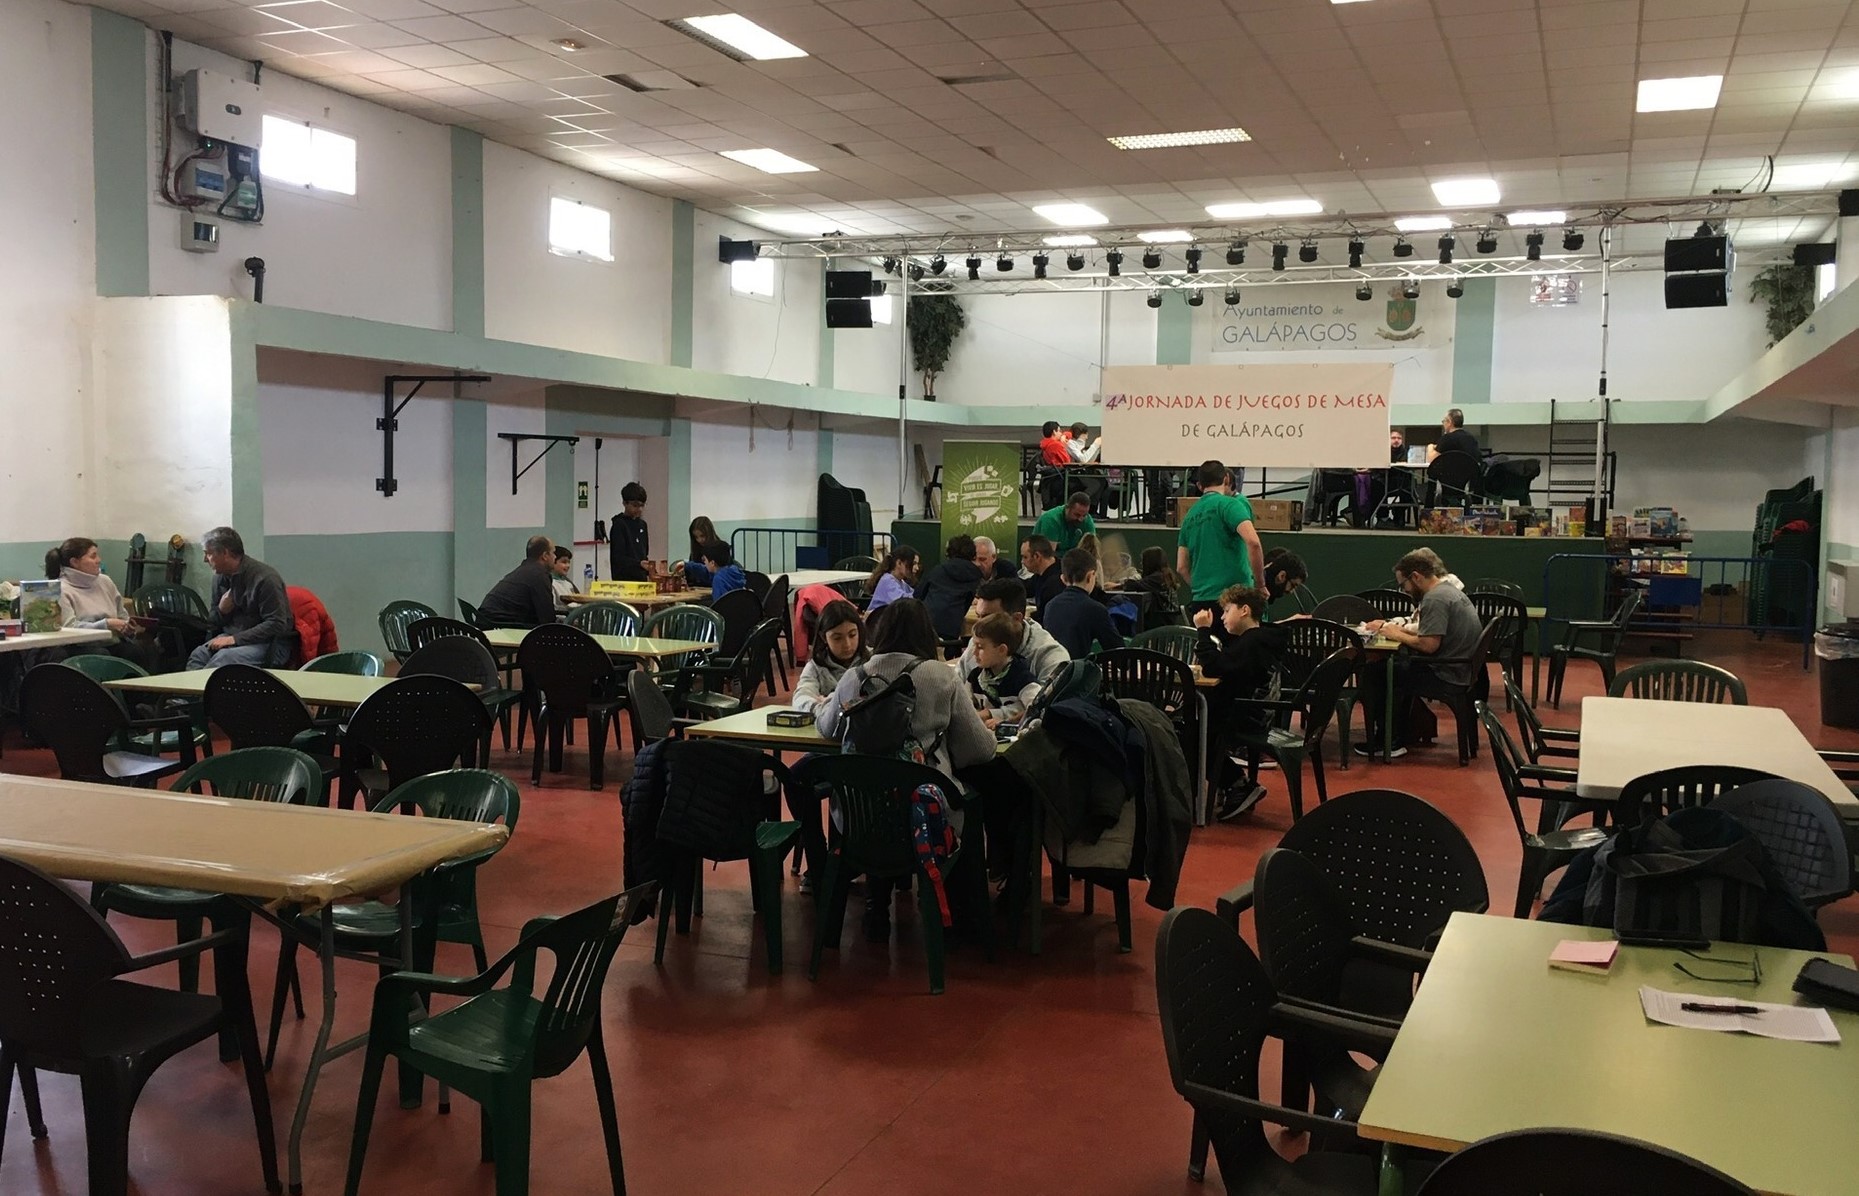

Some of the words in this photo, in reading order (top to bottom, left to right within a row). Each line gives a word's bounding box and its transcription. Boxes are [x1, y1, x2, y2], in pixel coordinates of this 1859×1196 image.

[1223, 303, 1323, 320] Ayuntamiento
[1332, 305, 1344, 315] de
[1222, 321, 1357, 344] GALÁPAGOS
[1127, 394, 1207, 411] JORNADA
[1213, 394, 1232, 409] DE
[1236, 394, 1301, 411] JUEGOS
[1307, 394, 1328, 409] DE
[1333, 393, 1386, 409] MESA
[1181, 423, 1200, 438] DE
[1206, 421, 1304, 439] GALÁPAGOS
